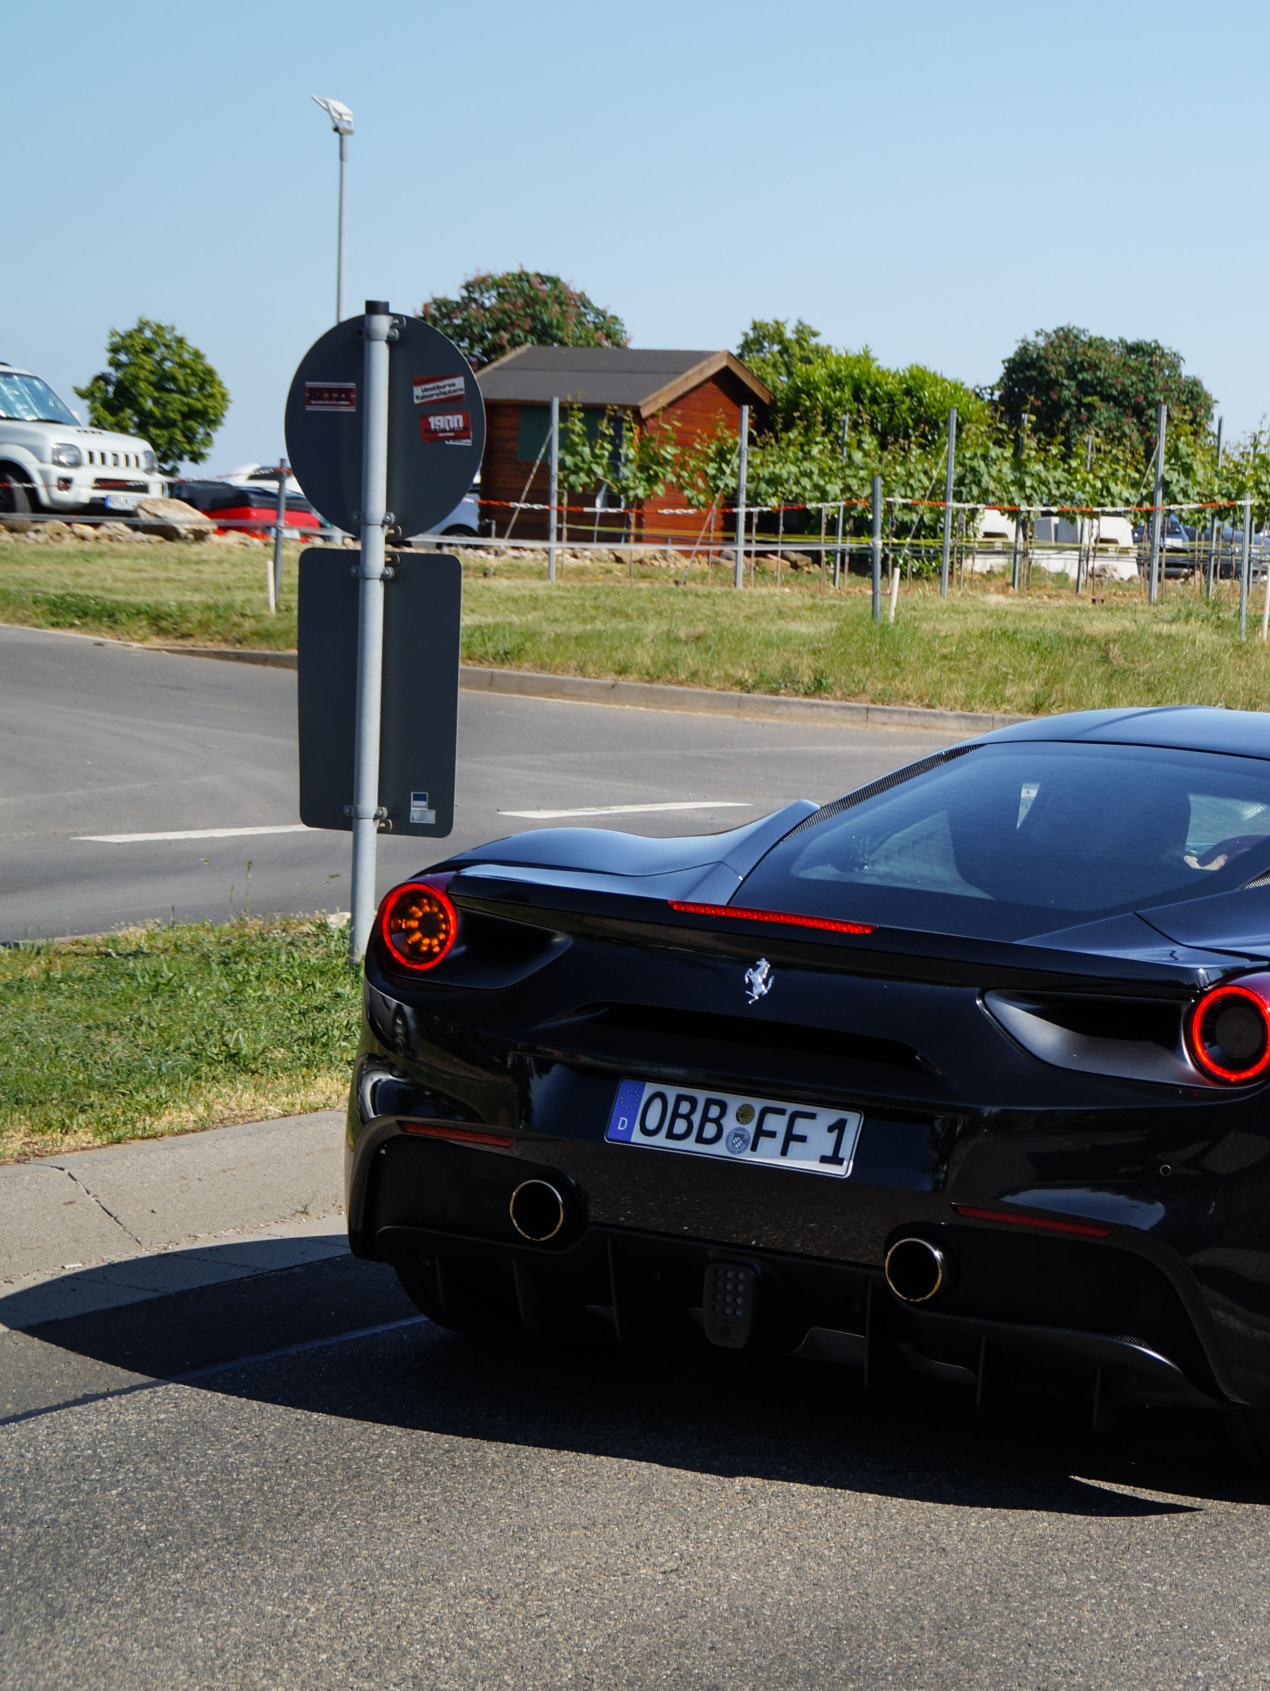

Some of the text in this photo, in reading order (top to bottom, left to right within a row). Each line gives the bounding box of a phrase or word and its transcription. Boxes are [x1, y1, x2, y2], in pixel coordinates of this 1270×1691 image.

[428, 414, 464, 430] 1900
[617, 1117, 628, 1131] D
[638, 1091, 728, 1145] OBB
[750, 1106, 817, 1157] FF
[819, 1118, 848, 1166] 1
